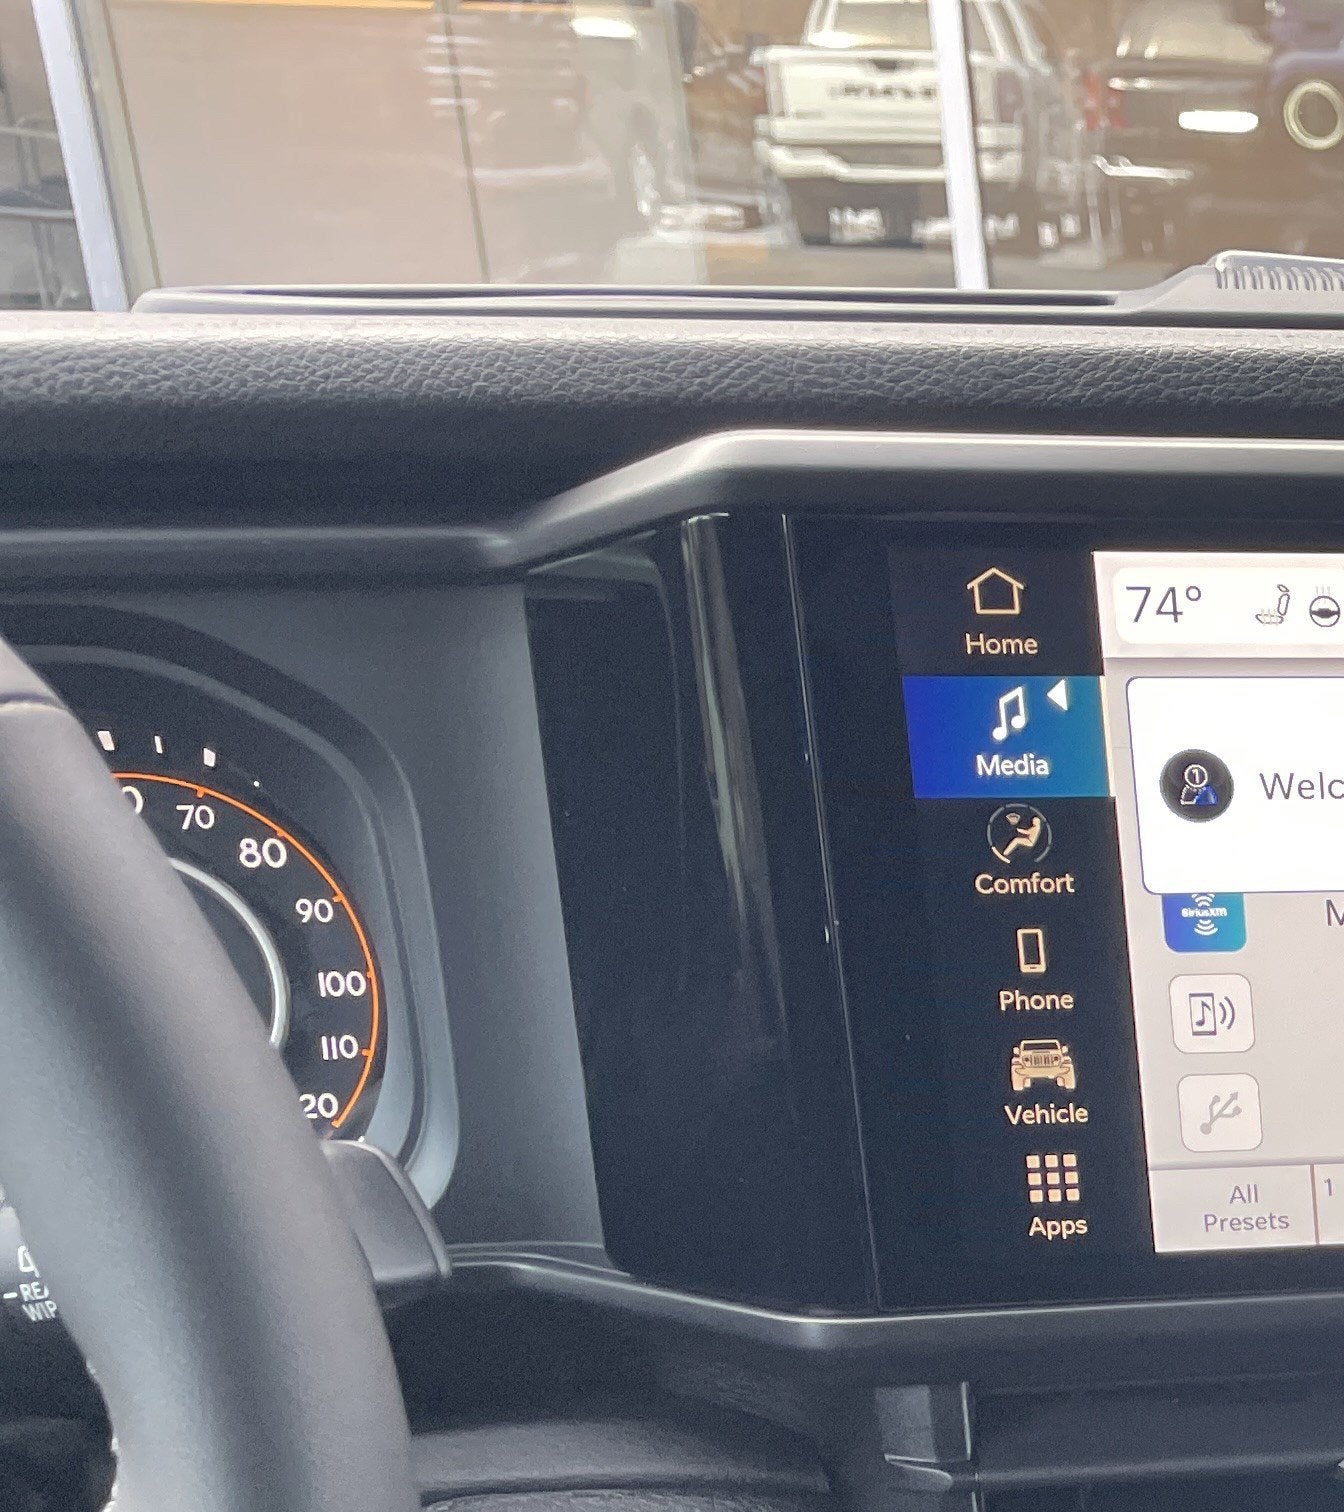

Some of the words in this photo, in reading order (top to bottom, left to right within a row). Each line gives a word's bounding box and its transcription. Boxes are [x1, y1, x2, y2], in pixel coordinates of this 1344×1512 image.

[1125, 585, 1202, 624] 74°
[965, 633, 1038, 655] Home
[976, 753, 1050, 777] Media
[175, 804, 215, 830] 70
[239, 838, 288, 869] 80
[974, 873, 1075, 894] Comfort
[295, 898, 334, 923] 90
[318, 970, 367, 998] 100
[999, 990, 1075, 1012] Phone
[321, 1034, 359, 1061] 110
[299, 1092, 339, 1119] 20
[1004, 1103, 1089, 1125] Vehicle
[1230, 1184, 1259, 1205] All
[1324, 1178, 1333, 1197] 1
[1028, 1216, 1088, 1240] Apps
[1204, 1210, 1290, 1233] Presets
